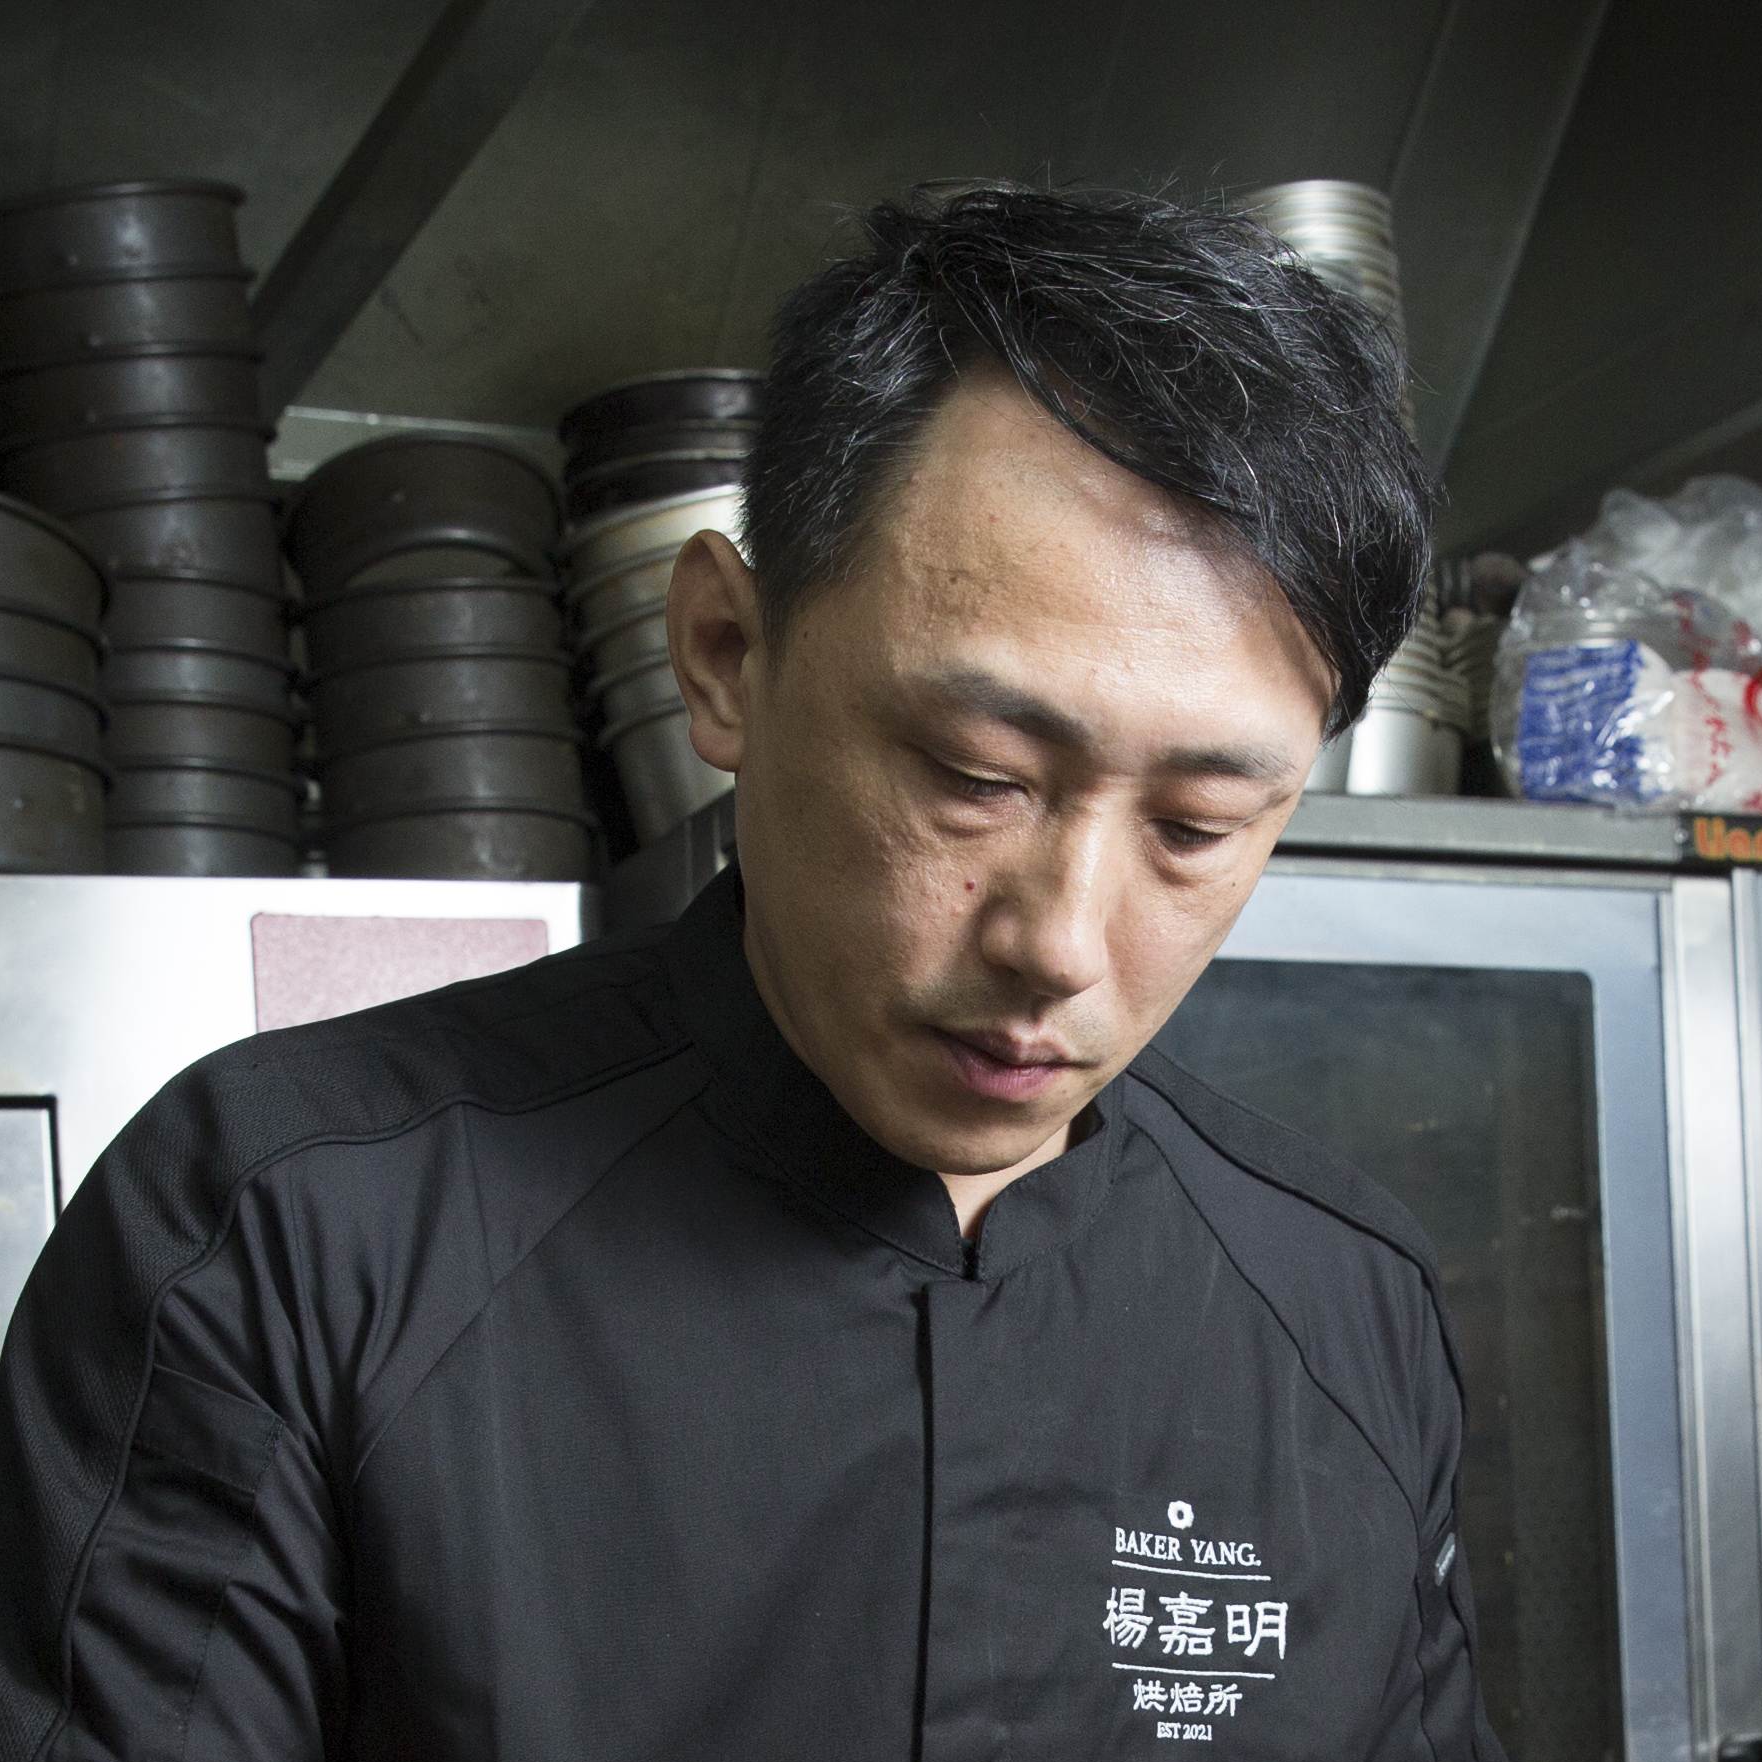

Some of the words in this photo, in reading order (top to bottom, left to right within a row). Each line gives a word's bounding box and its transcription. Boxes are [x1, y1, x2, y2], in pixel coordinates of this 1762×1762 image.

[1115, 1527, 1183, 1561] BAKER
[1190, 1538, 1262, 1567] YANG.
[1102, 1586, 1289, 1660] 楊嘉明
[1133, 1678, 1243, 1717] 烘焙所
[1156, 1721, 1181, 1739] EST
[1183, 1724, 1213, 1741] 2021
